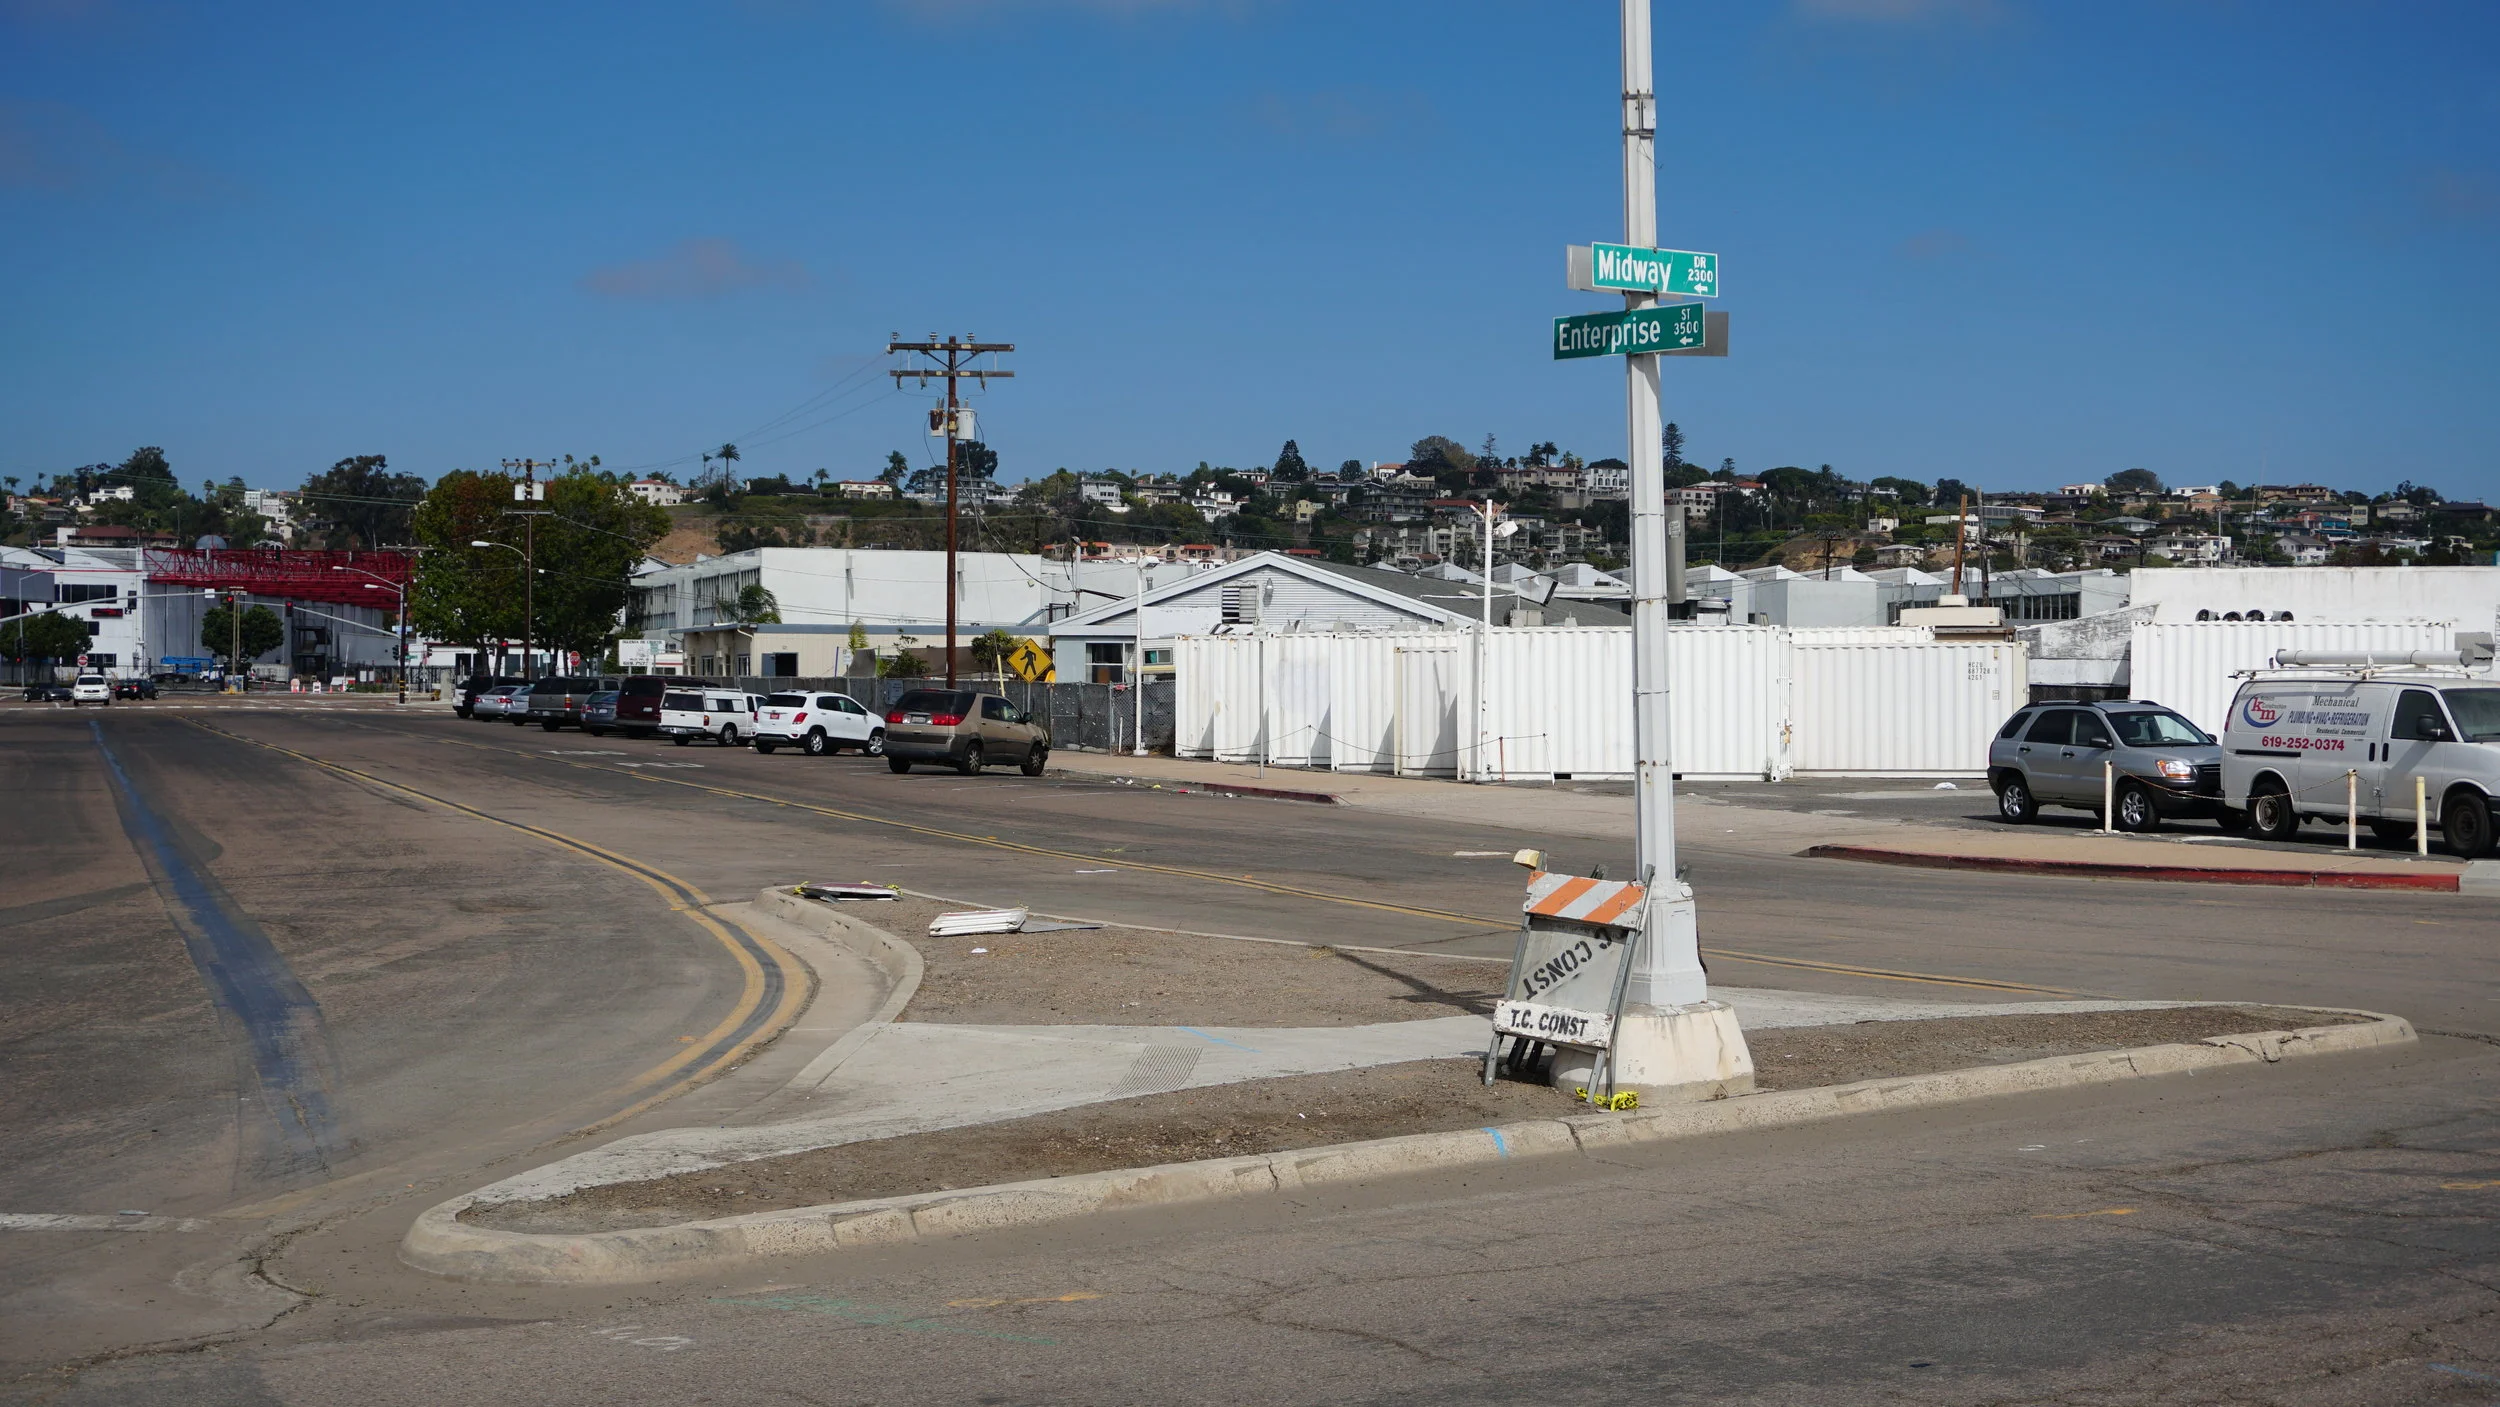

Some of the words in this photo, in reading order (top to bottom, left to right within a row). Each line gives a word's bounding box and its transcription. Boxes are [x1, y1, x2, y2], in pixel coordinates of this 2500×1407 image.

[1693, 256, 1706, 268] DR
[1598, 249, 1671, 291] Midway
[1687, 269, 1714, 282] 2300
[1681, 308, 1691, 321] ST
[1558, 317, 1661, 353] Enterprise
[1673, 320, 1699, 335] 3500
[2312, 695, 2360, 708] Mechanical
[2316, 727, 2340, 735] Residential
[2341, 728, 2367, 736] Commercial
[2262, 736, 2345, 751] 619-252-0374
[1523, 941, 1592, 1001] CONST
[1510, 1009, 1533, 1029] T.C.
[1539, 1013, 1588, 1037] CONST
